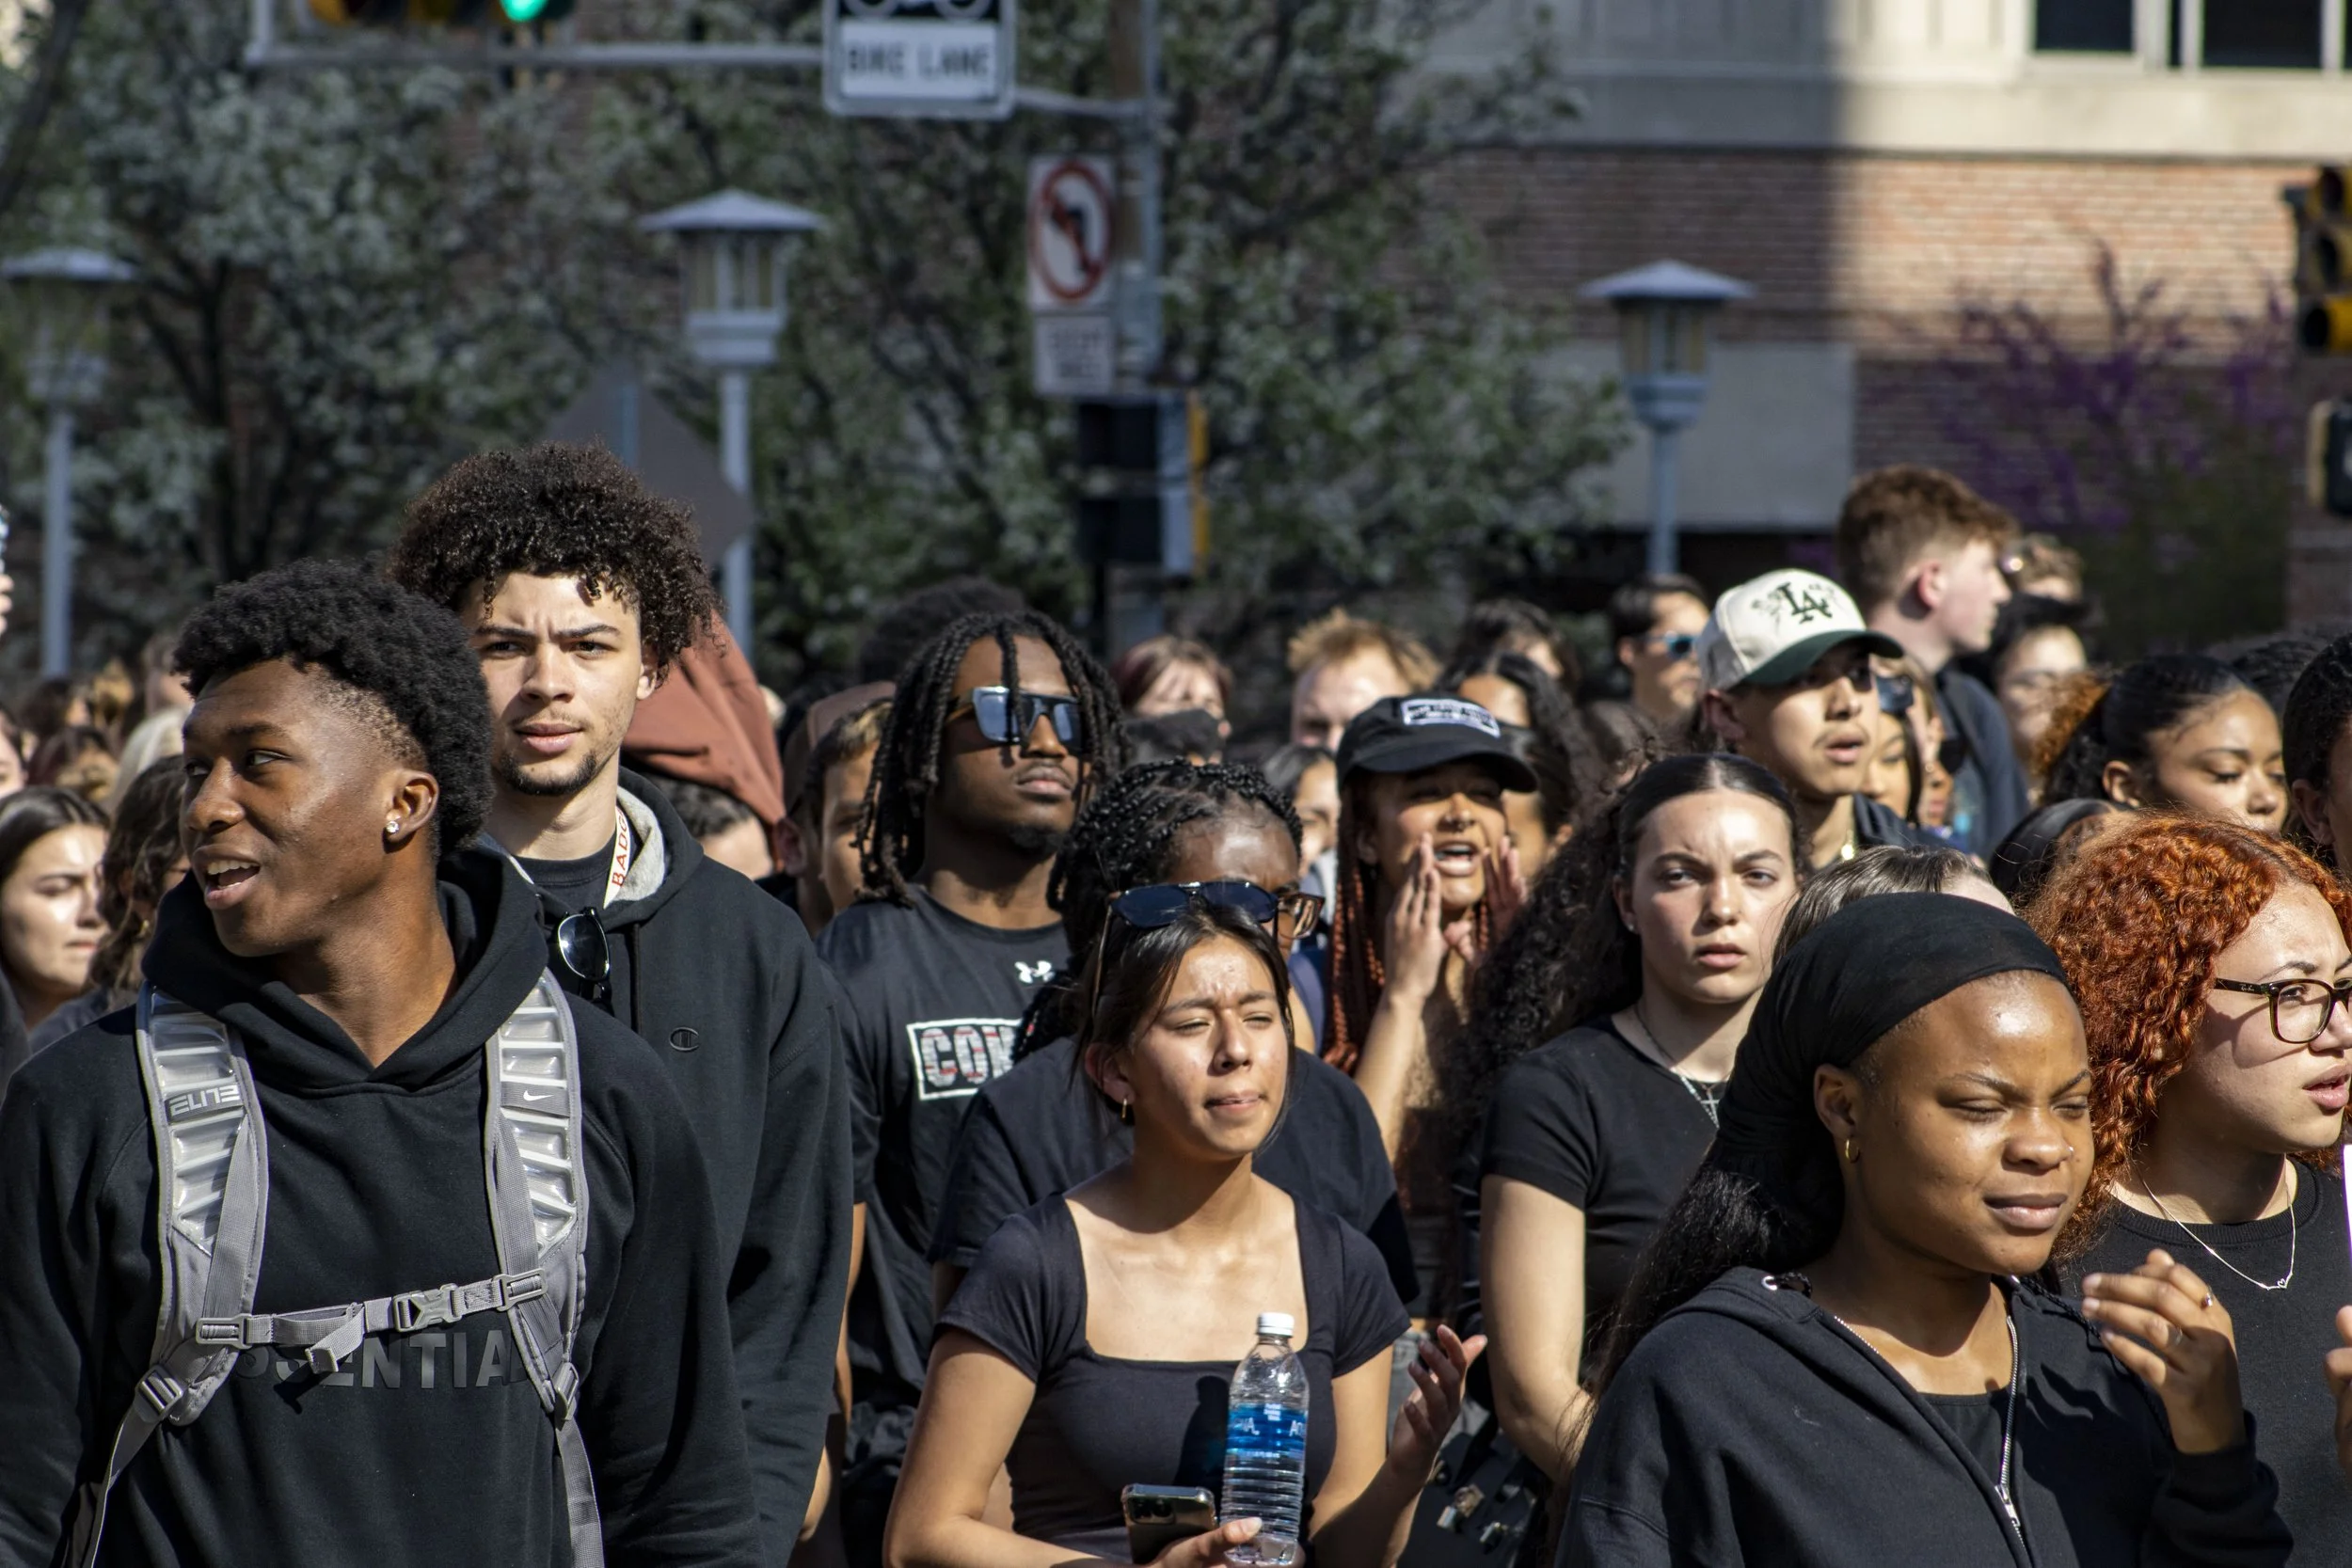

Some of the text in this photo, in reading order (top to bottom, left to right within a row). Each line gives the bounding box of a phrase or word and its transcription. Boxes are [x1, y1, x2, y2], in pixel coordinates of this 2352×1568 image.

[848, 43, 988, 79] BIKE LANE
[1776, 581, 1833, 625] LA
[612, 808, 628, 888] BADG
[169, 1084, 240, 1117] ELITE
